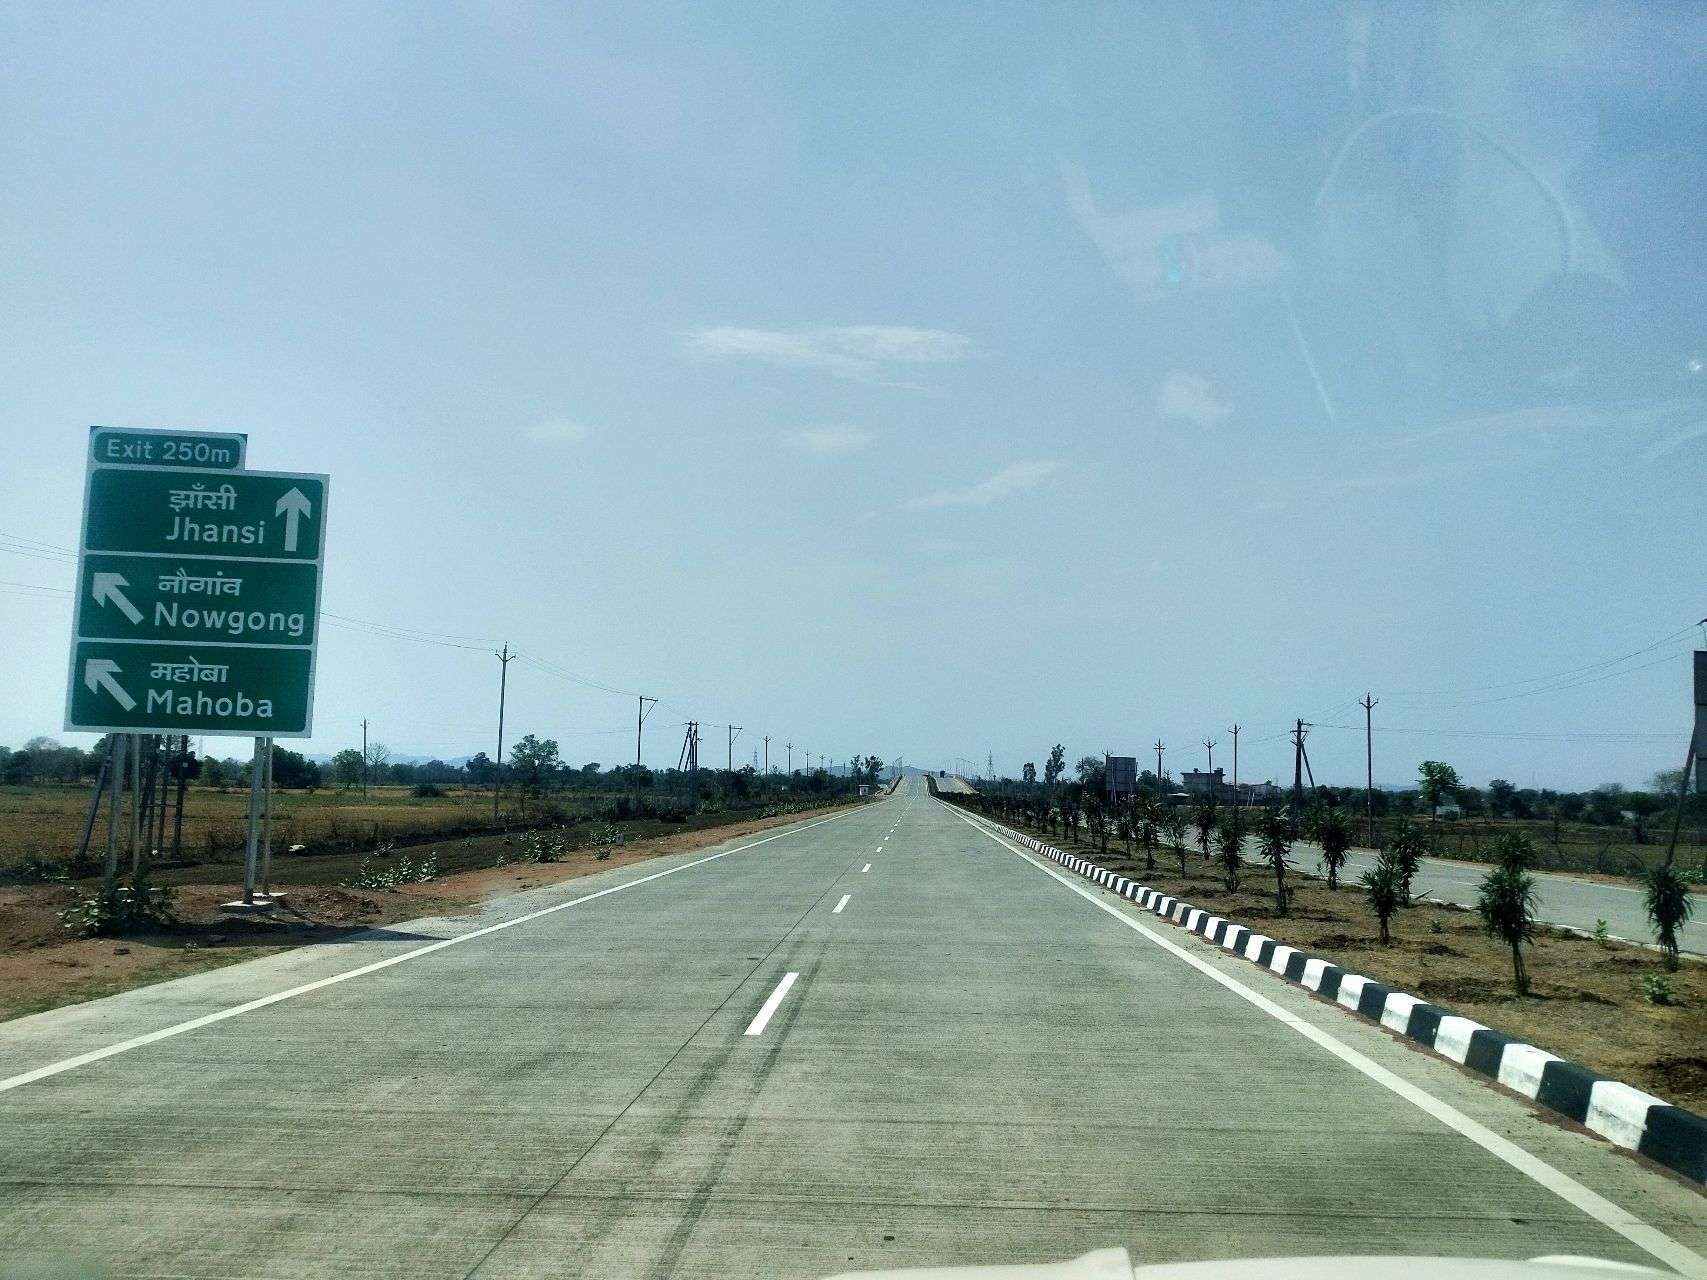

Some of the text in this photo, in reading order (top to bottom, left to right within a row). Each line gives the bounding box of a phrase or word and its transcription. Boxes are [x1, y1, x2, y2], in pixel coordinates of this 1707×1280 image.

[107, 439, 231, 463] Exit 250m
[169, 482, 238, 512] झाँसी
[166, 516, 265, 544] Jhansi
[158, 567, 242, 597] नौगांव
[154, 601, 305, 637] Nowgong
[150, 655, 229, 684] महोबा
[146, 688, 273, 718] Mahoba
